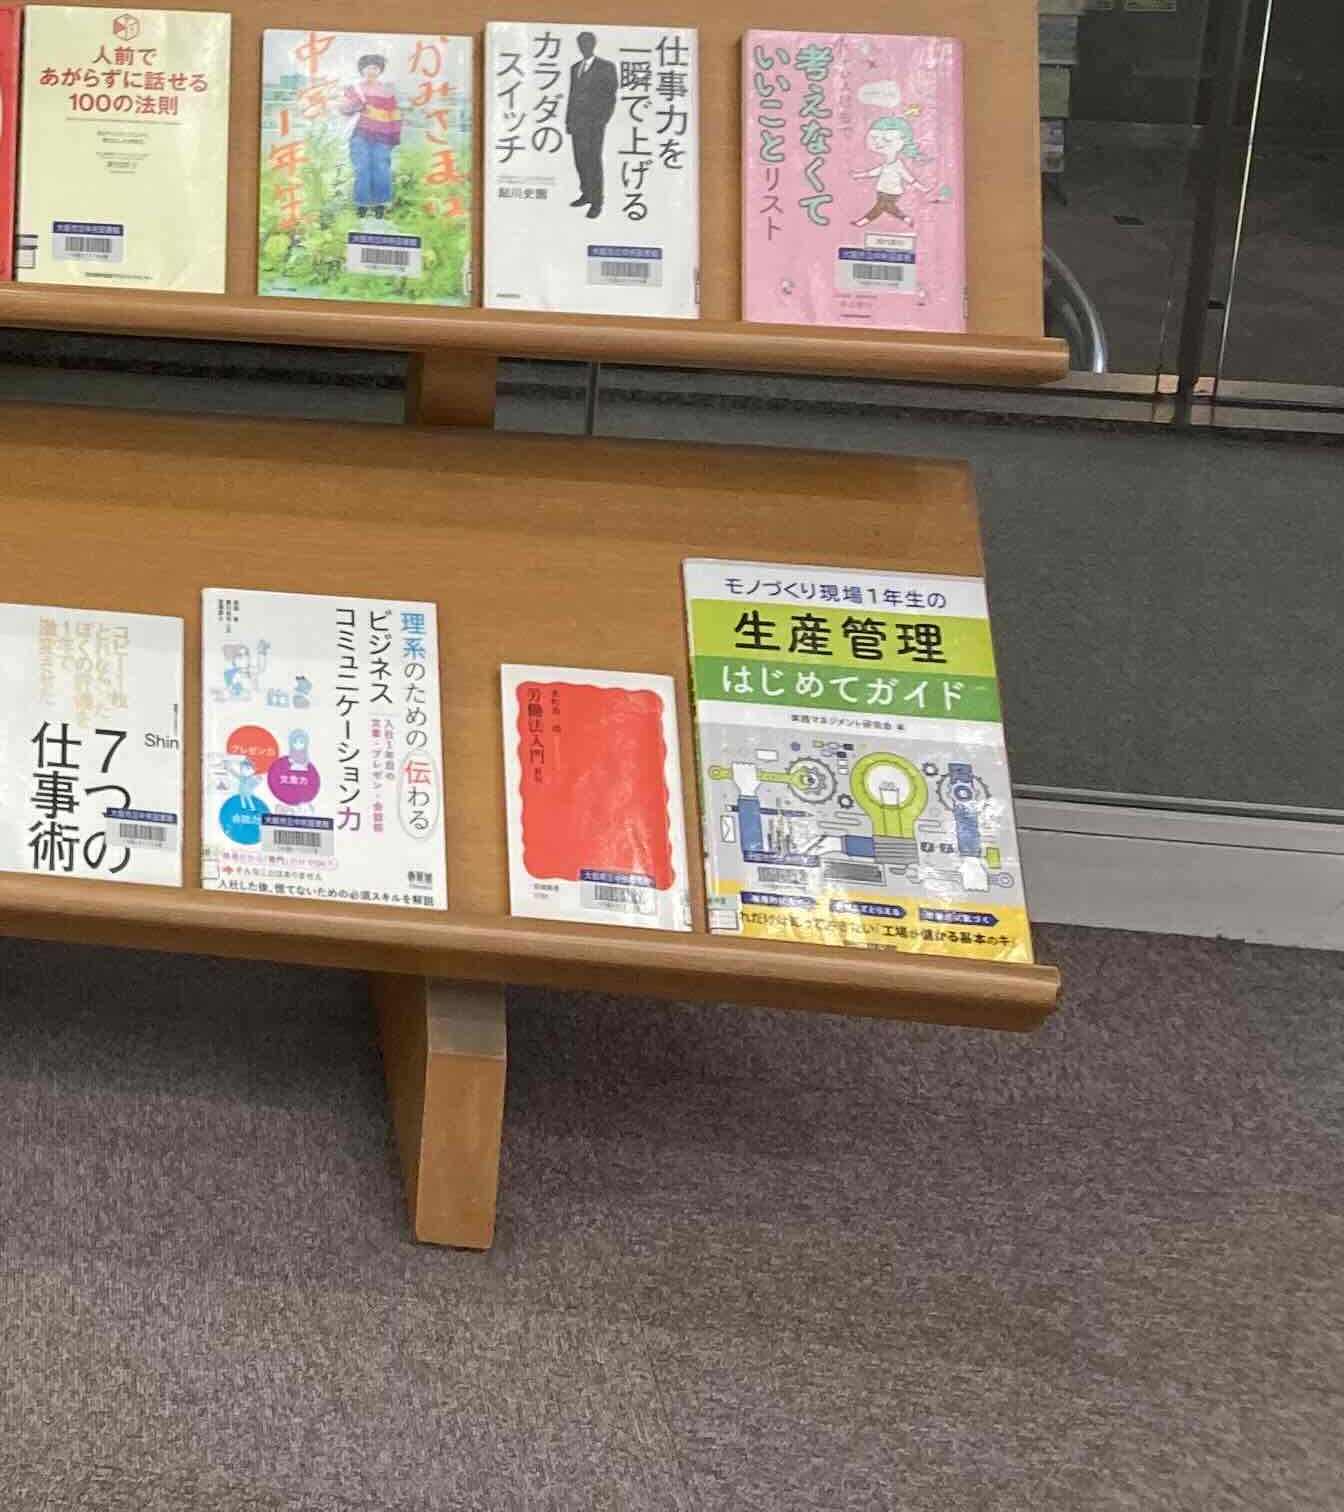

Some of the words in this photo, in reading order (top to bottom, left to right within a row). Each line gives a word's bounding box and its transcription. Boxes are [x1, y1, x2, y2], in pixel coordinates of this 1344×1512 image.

[39, 67, 209, 93] あがらずに話せる
[68, 93, 179, 116] 100の法則
[92, 46, 158, 66] 人前で
[495, 52, 527, 164] スイッチ
[531, 31, 564, 154] カラダの
[655, 35, 690, 170] 仕事力を
[617, 47, 653, 222] 一瞬で上げる
[752, 44, 791, 241] いいことリスト
[794, 42, 833, 227] 考えなくて
[724, 577, 947, 610] モノづくり現場1年生の
[733, 609, 948, 665] 生産管理
[369, 609, 393, 705] ビジネス
[721, 663, 965, 712] はじめてガイド
[144, 732, 179, 750] Shin
[335, 606, 362, 832] コミュニケーション力
[28, 721, 83, 872] 仕事術
